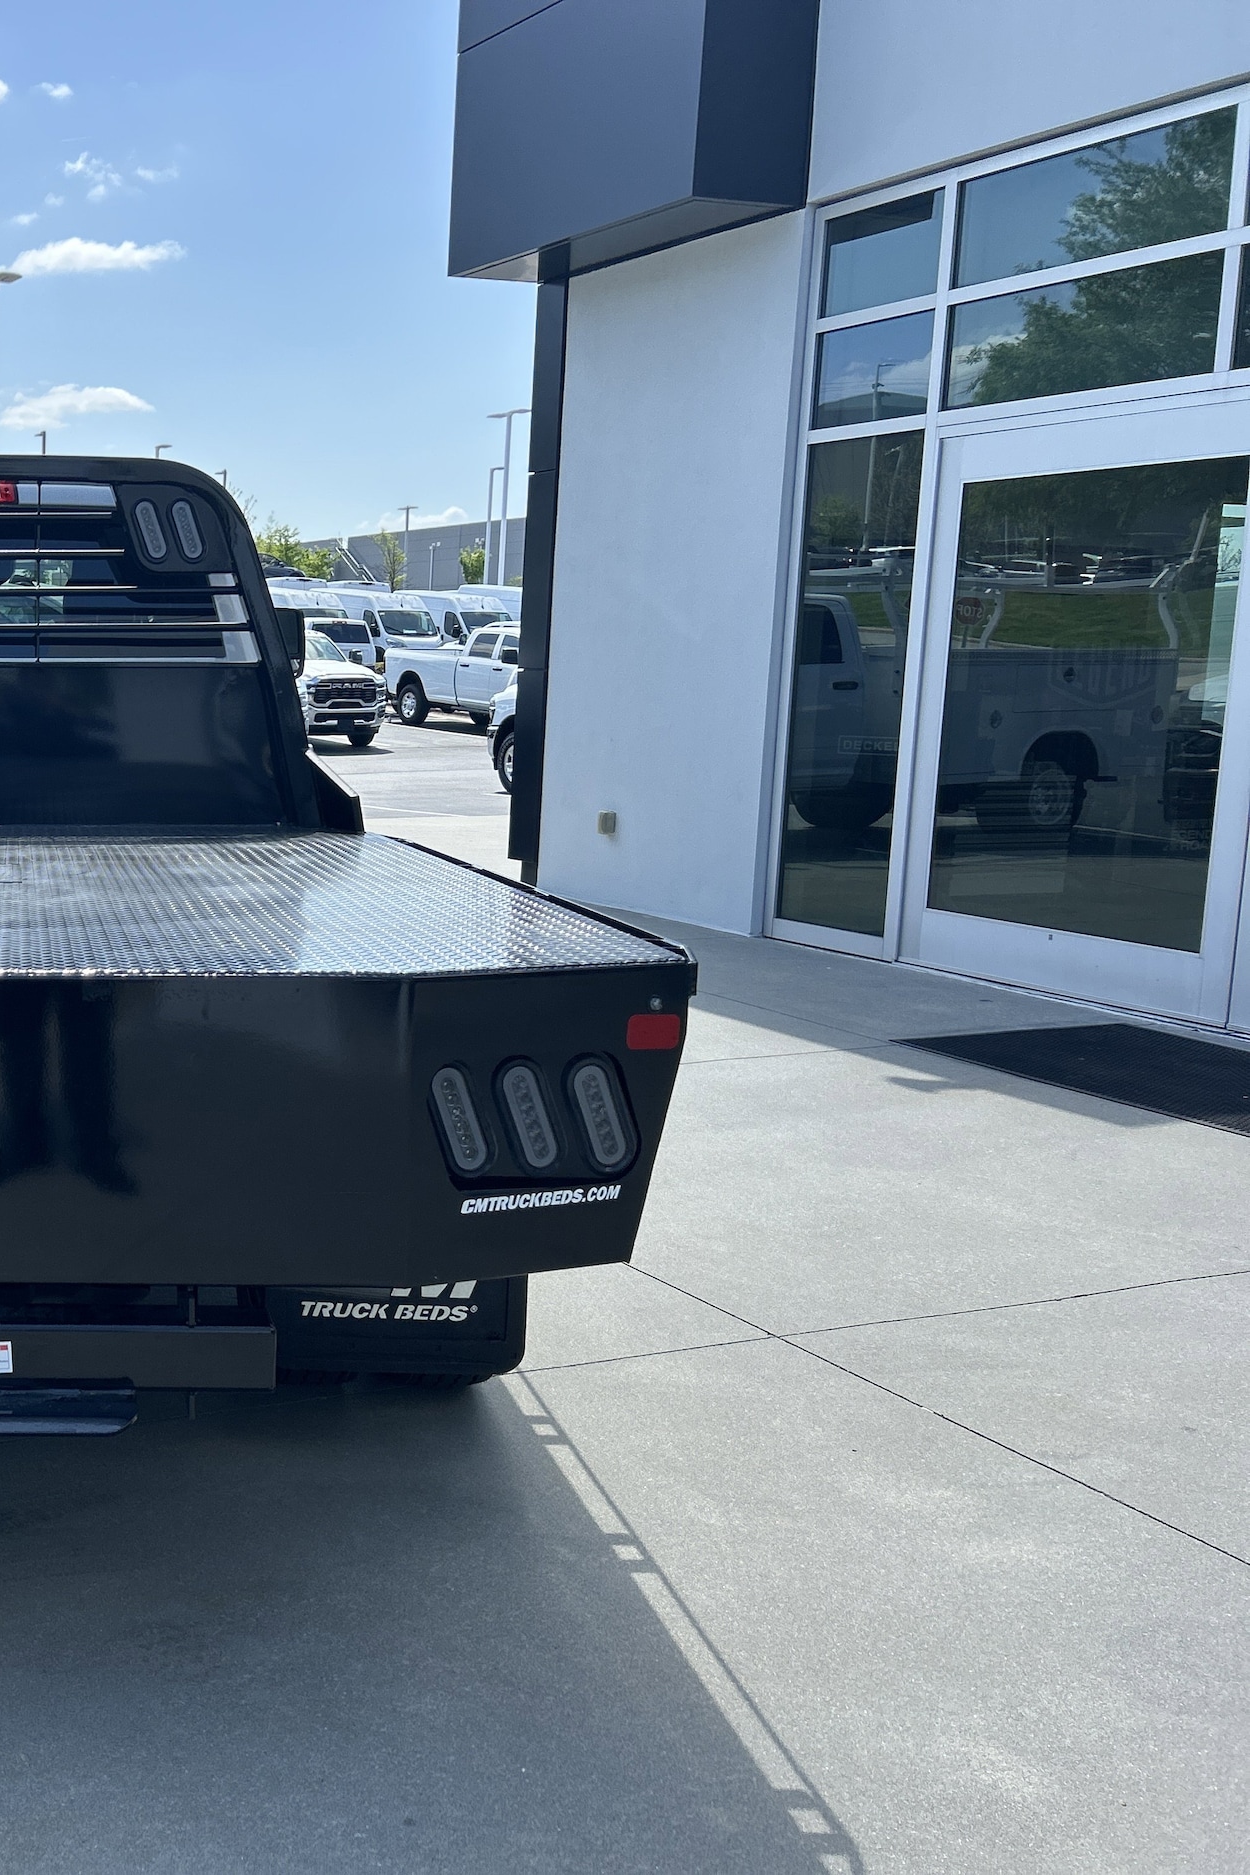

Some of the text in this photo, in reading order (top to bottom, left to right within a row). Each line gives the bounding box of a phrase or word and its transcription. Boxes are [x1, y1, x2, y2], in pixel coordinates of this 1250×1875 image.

[332, 682, 363, 690] RAM
[460, 1184, 622, 1215] CMTRUCKBEDS.COM
[301, 1301, 390, 1320] TRUCK
